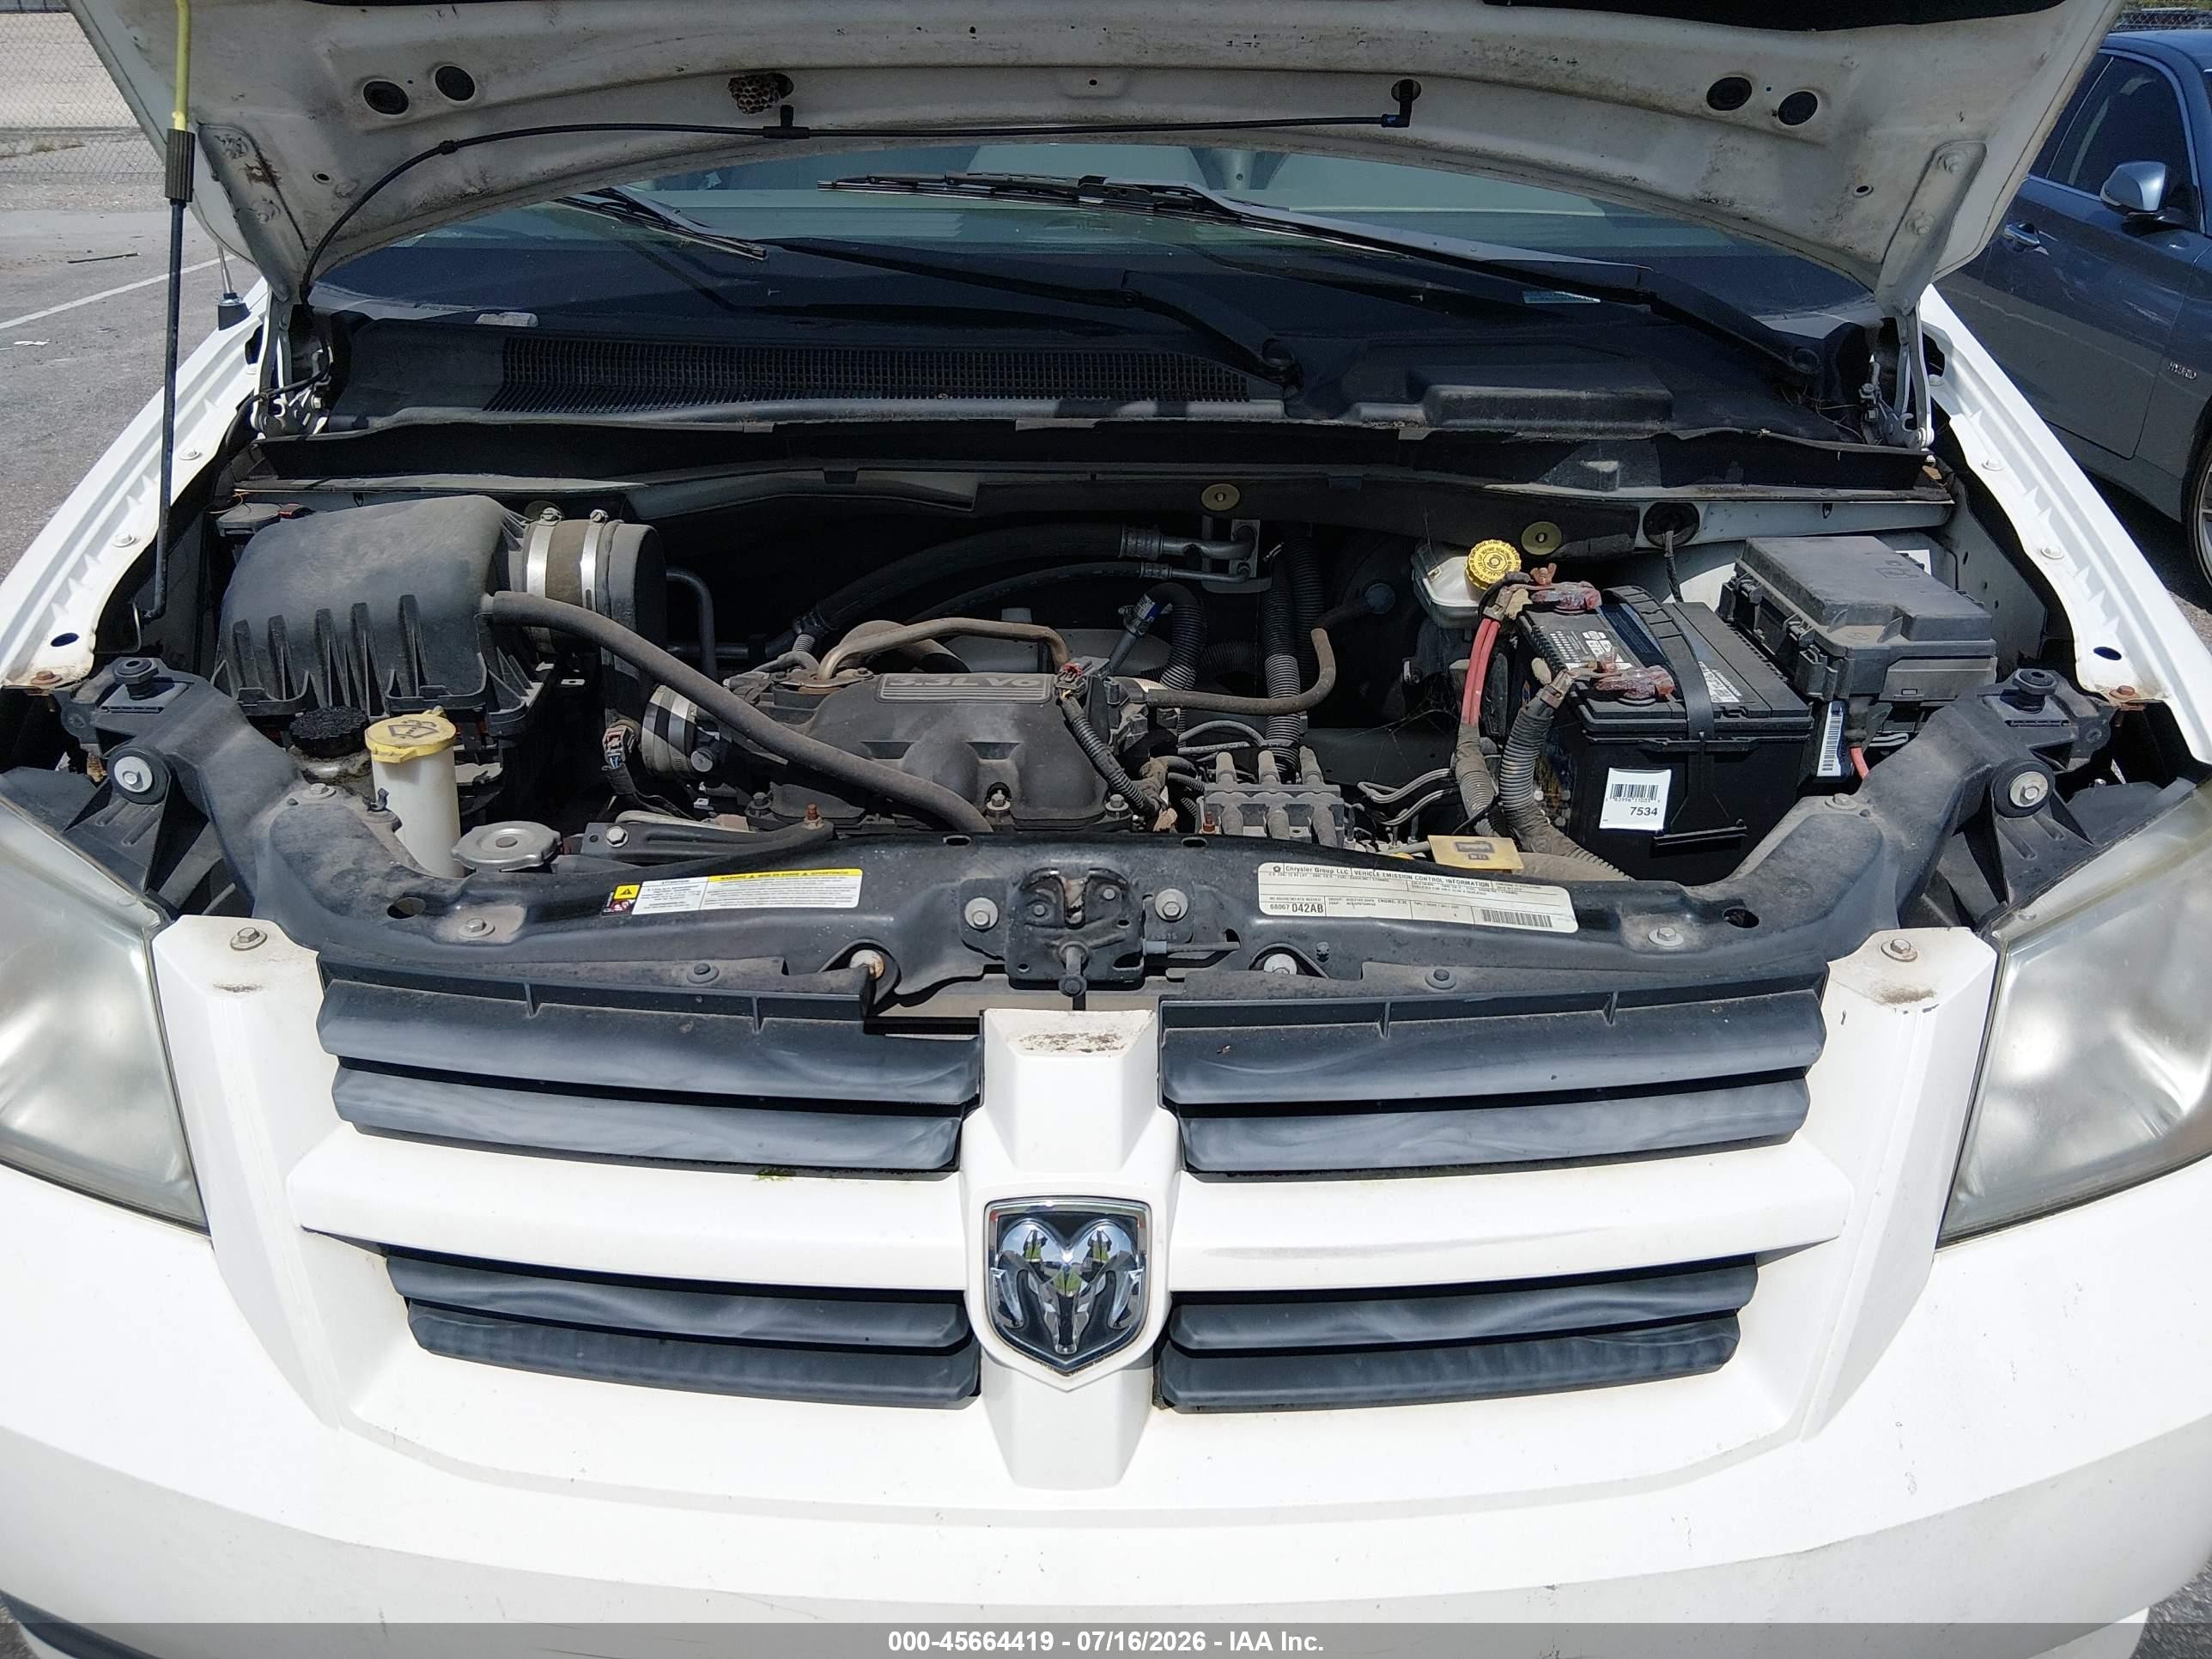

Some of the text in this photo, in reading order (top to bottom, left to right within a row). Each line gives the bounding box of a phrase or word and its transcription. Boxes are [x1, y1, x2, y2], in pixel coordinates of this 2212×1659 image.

[890, 677, 1041, 687] 3.3L V6
[1630, 806, 1658, 817] 7534
[1382, 872, 1413, 880] EMISSION
[1414, 874, 1444, 884] CONTROL
[1446, 878, 1490, 888] INFORMATION
[1291, 902, 1324, 913] 042AB
